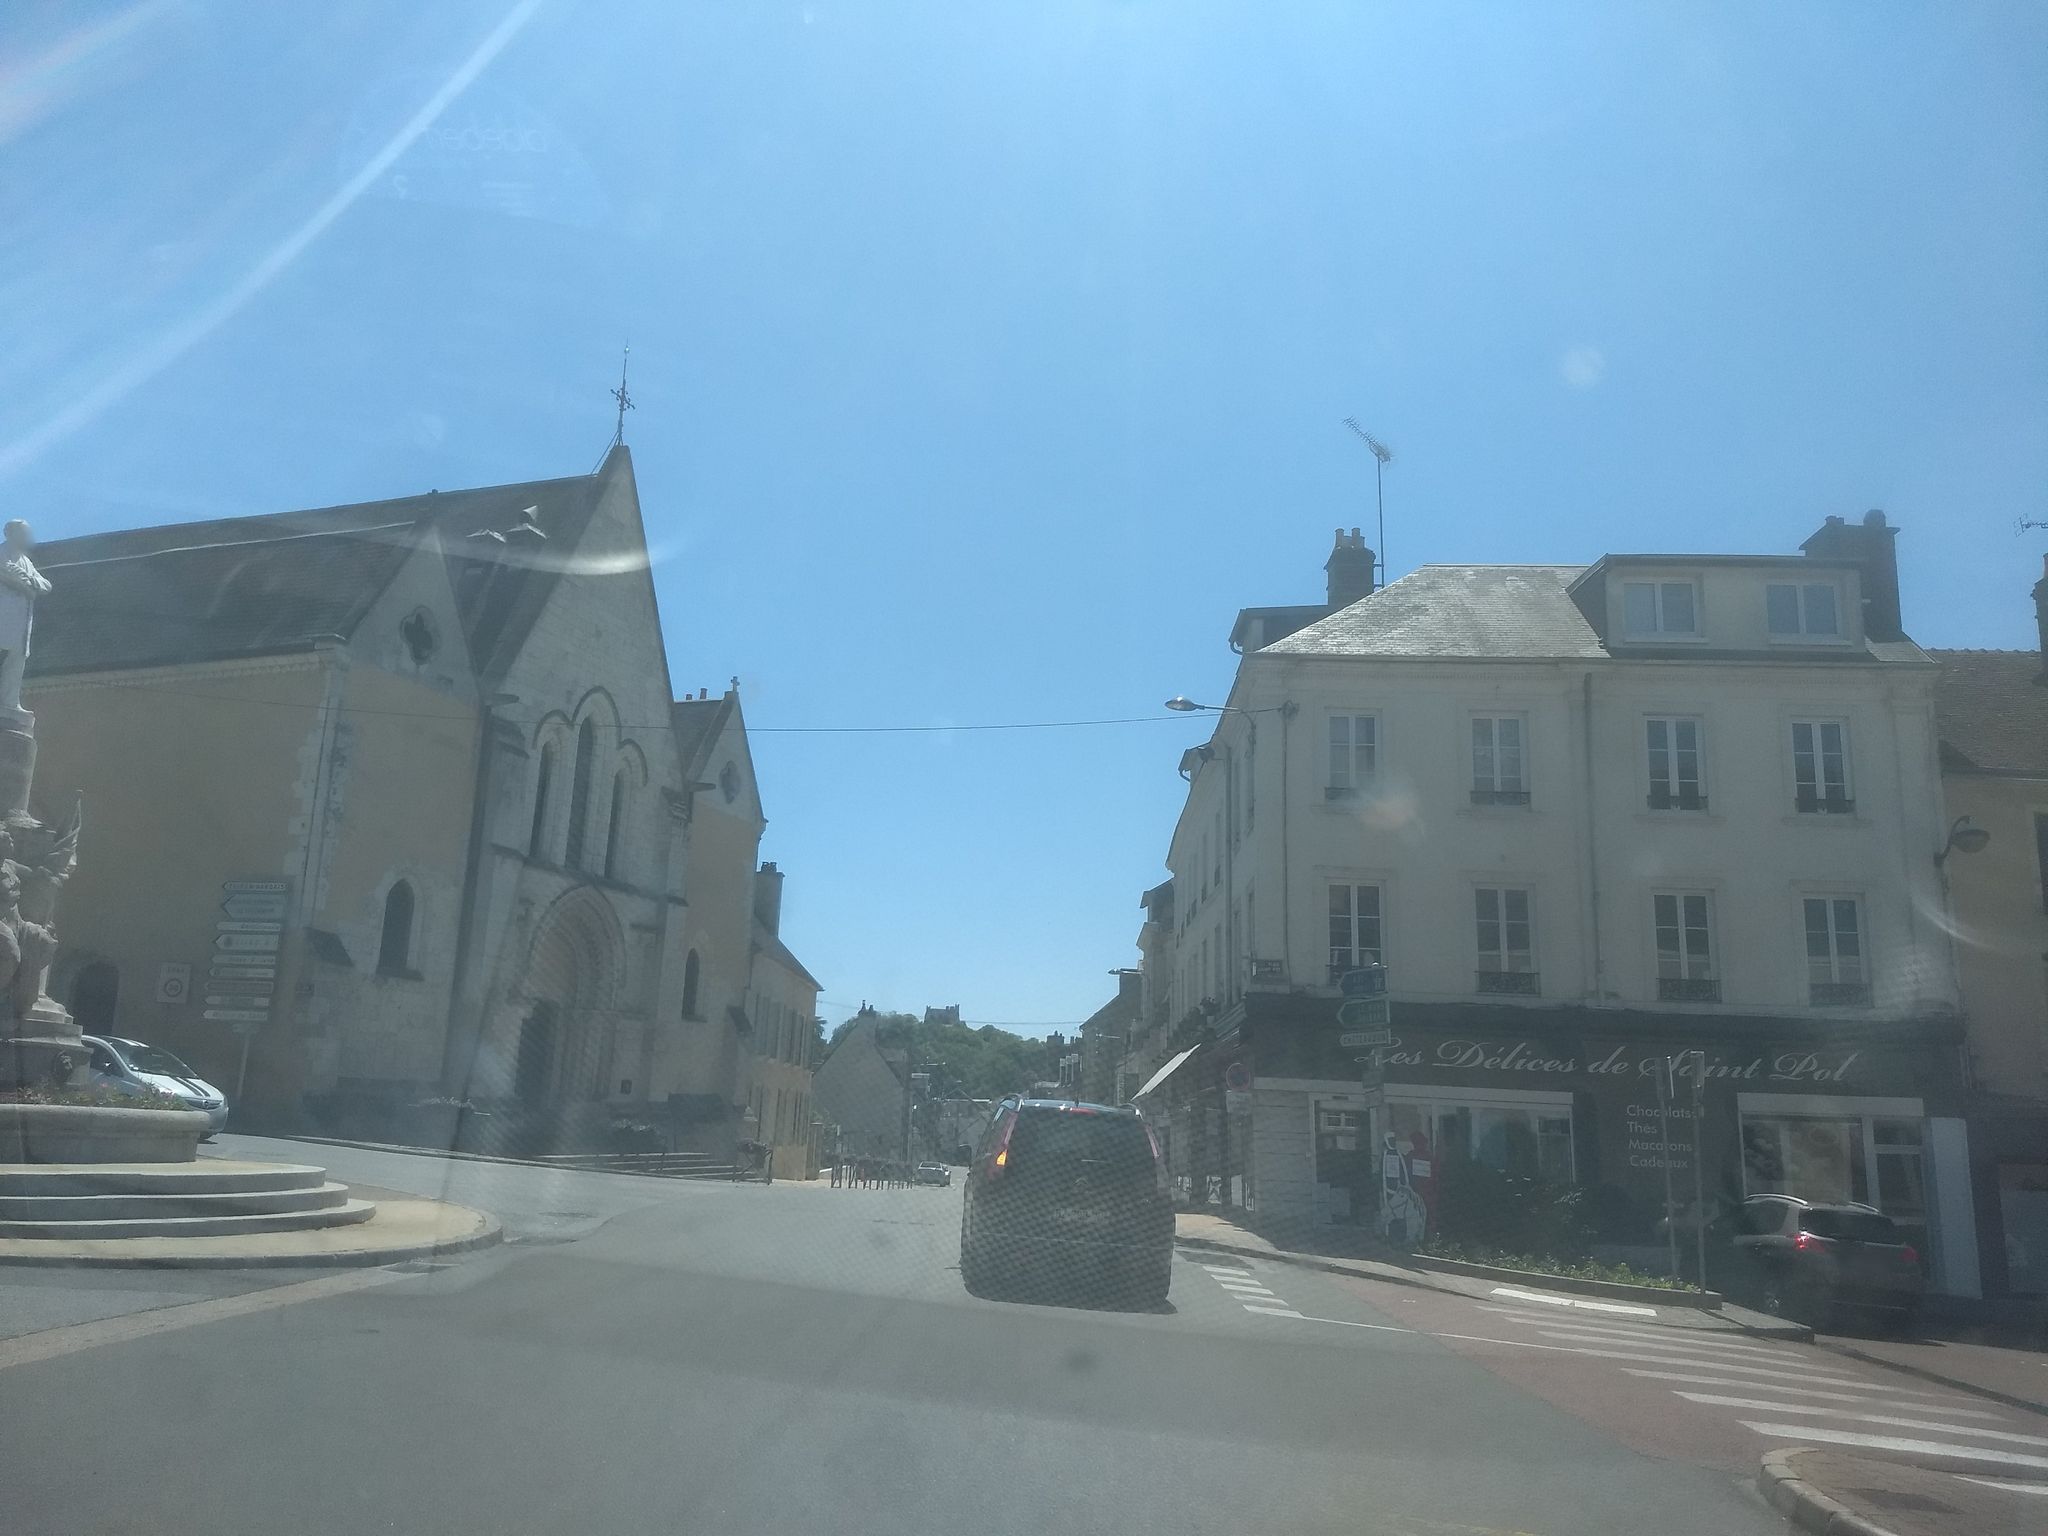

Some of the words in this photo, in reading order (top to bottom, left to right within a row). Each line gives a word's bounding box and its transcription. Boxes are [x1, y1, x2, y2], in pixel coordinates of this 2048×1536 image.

[1432, 1040, 1579, 1073] Délices
[1587, 1046, 1630, 1075] de
[1638, 1048, 1763, 1080] Saint
[1768, 1049, 1862, 1082] Pol
